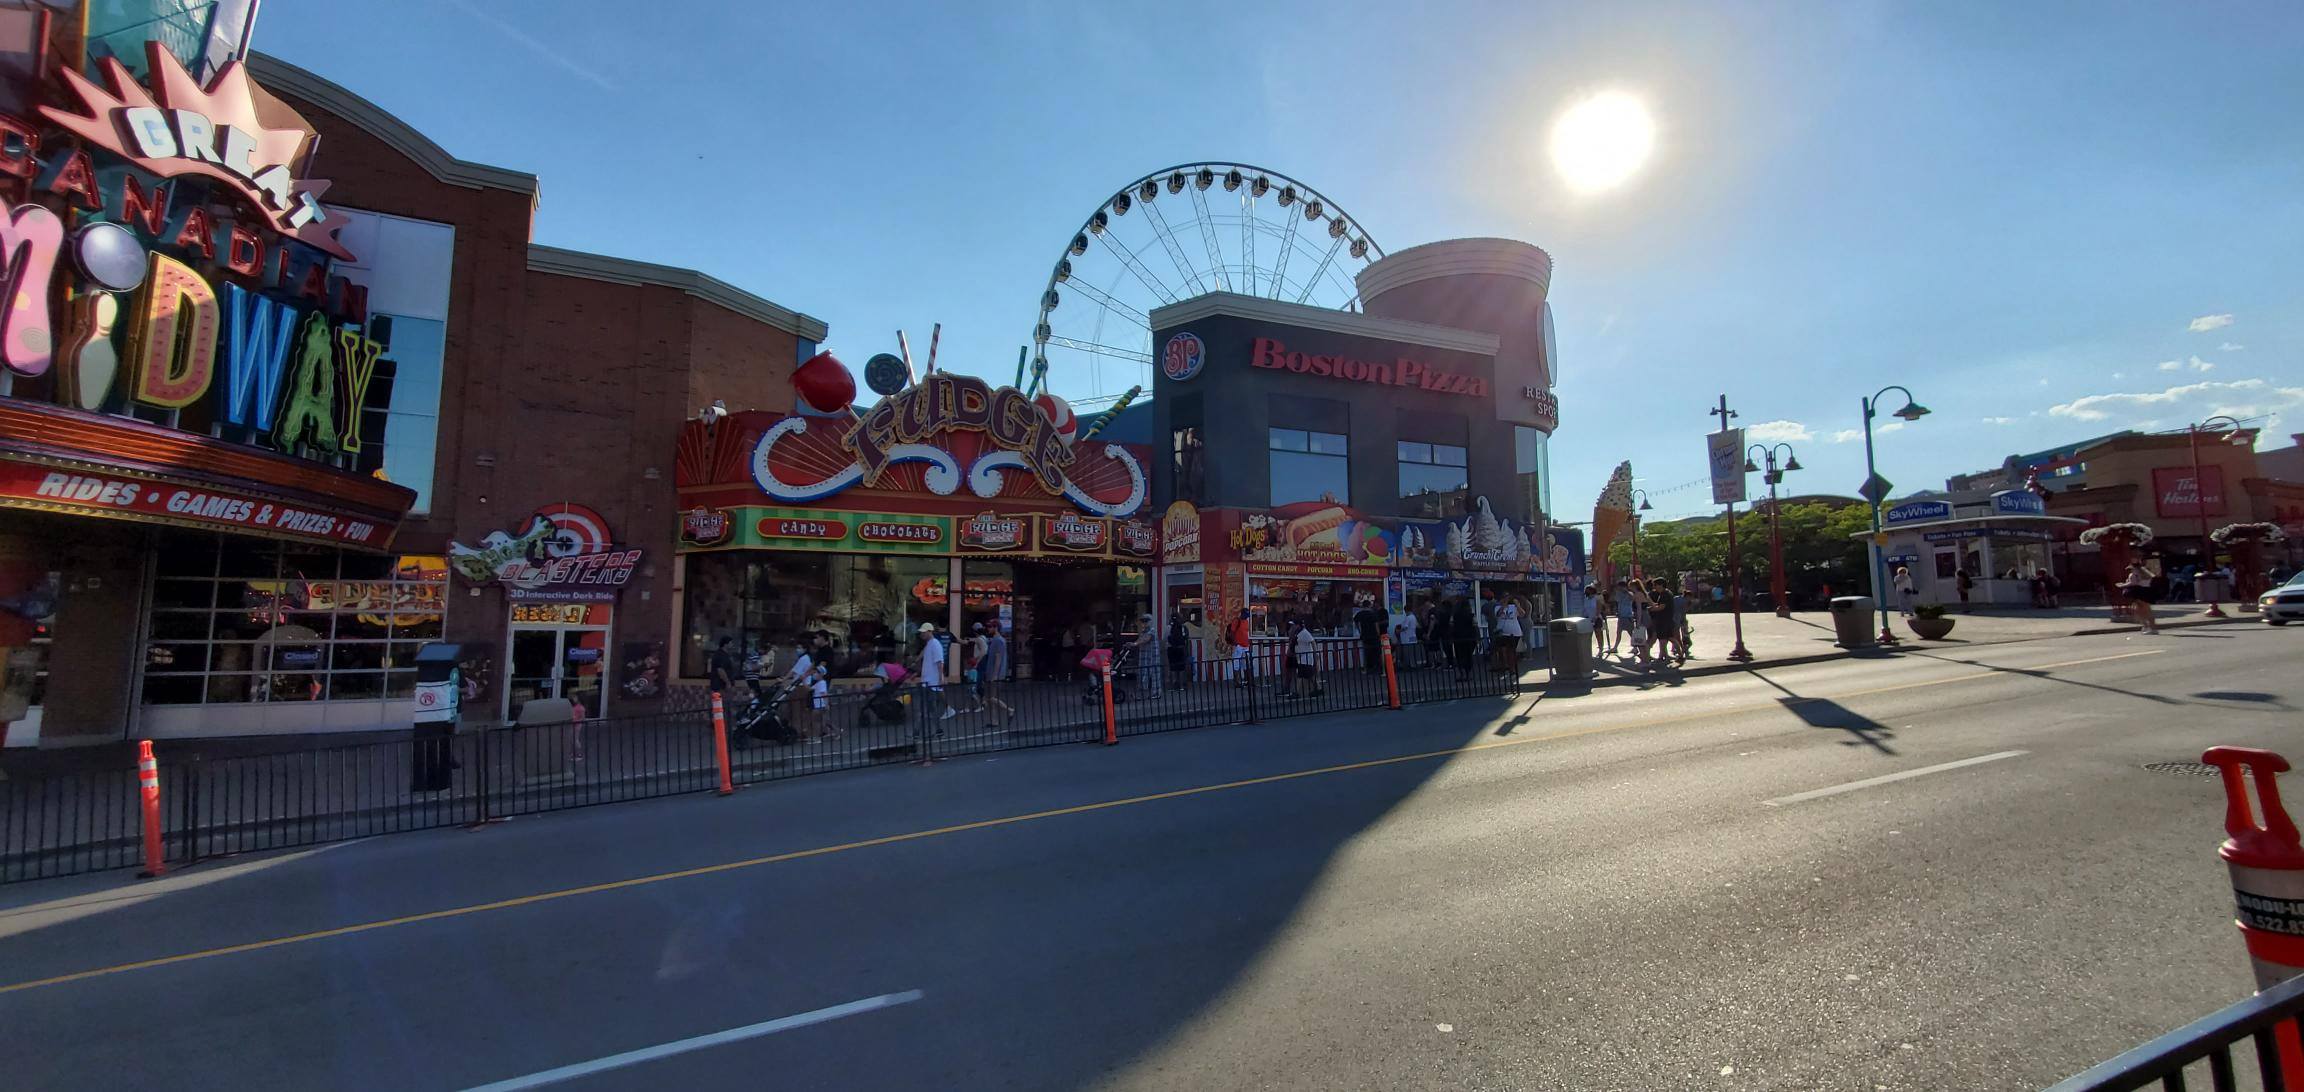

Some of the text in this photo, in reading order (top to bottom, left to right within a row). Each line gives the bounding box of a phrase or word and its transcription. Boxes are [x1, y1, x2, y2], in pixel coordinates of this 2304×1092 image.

[110, 106, 327, 229] GREAT
[1251, 338, 1490, 397] Boston Pizza
[843, 374, 1076, 494] FUDGE
[37, 471, 374, 542] RIDES GAMES & PRIZES FUN
[1889, 504, 1944, 521] SkyWheel
[780, 521, 827, 536] CANDY
[863, 524, 937, 540] CHOCOLATE
[970, 522, 1019, 533] FUDGE
[1054, 523, 1102, 534] FUDGE
[1164, 532, 1200, 553] POPCORN
[1230, 529, 1244, 550] Hot
[499, 550, 642, 585] BLASTERS
[526, 590, 571, 600] Interactive
